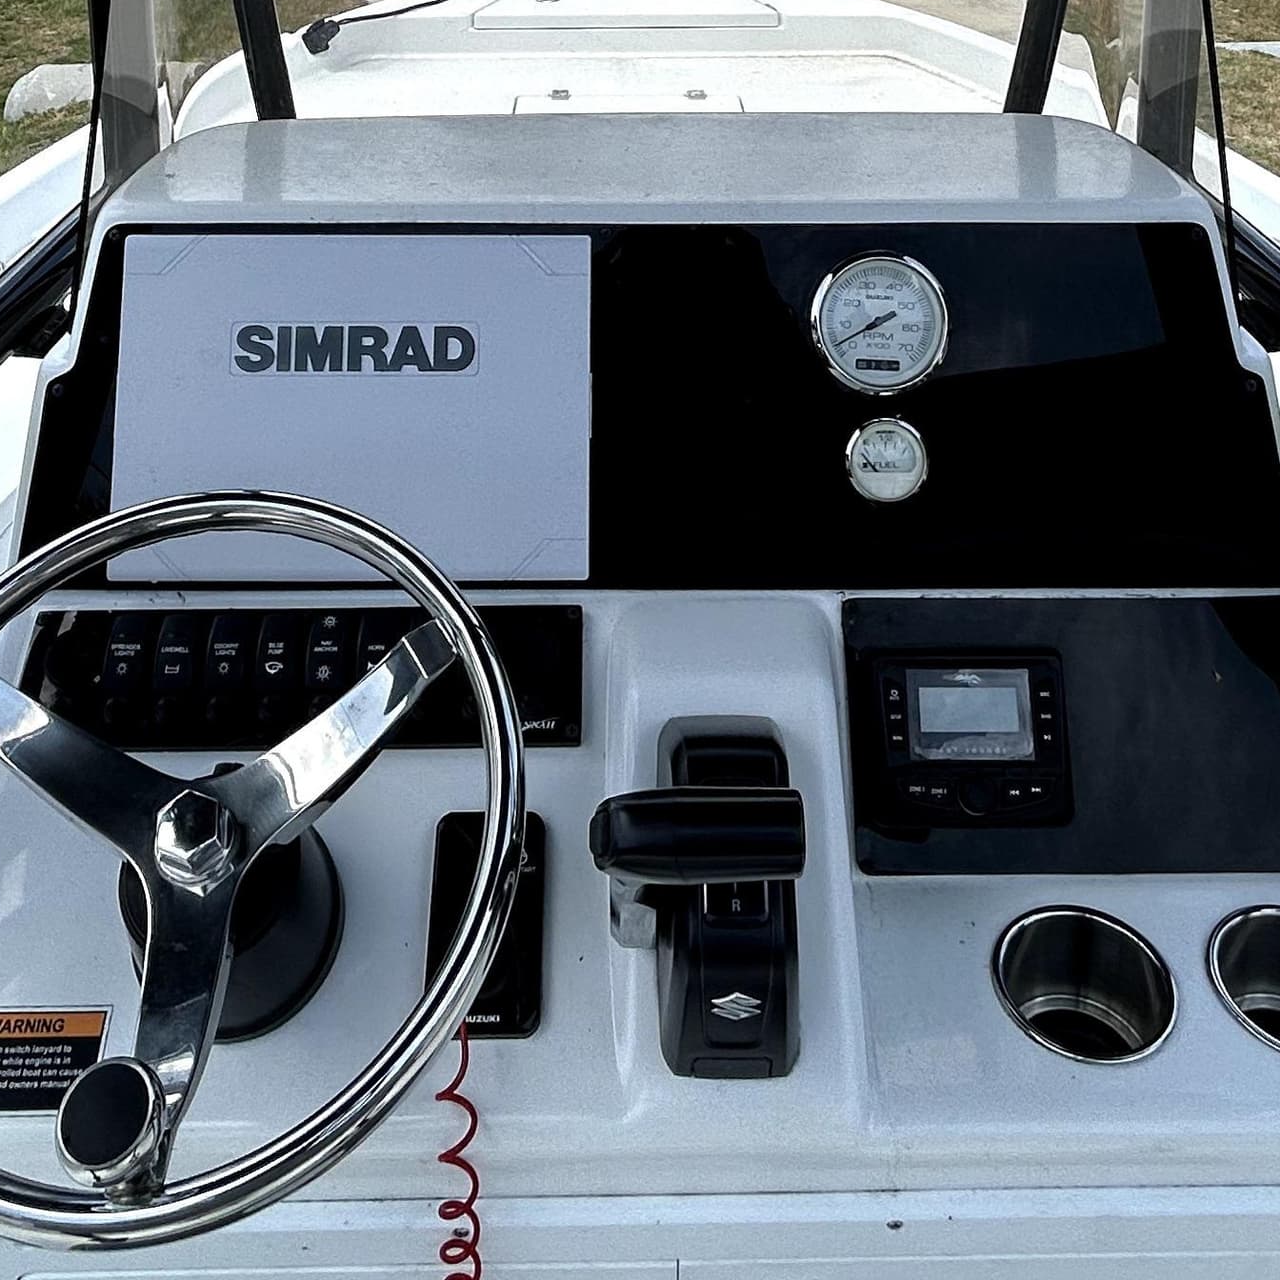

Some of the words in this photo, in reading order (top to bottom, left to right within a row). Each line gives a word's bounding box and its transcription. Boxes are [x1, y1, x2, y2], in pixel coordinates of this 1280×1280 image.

[859, 281, 876, 289] 30
[886, 282, 903, 290] 40
[844, 298, 860, 307] 20
[898, 301, 914, 310] 50
[840, 320, 851, 328] 10
[903, 323, 919, 332] 60
[863, 331, 893, 341] RPM
[234, 324, 476, 372] SIMRAD
[849, 340, 857, 349] 0
[898, 343, 913, 352] 70
[731, 898, 742, 912] R
[4, 1045, 31, 1054] switch
[31, 1045, 63, 1055] lanyard
[63, 1045, 73, 1054] to
[2, 1056, 24, 1066] while
[24, 1057, 53, 1067] engine
[53, 1056, 62, 1065] is
[62, 1056, 72, 1065] in
[22, 1068, 42, 1078] boat
[42, 1069, 58, 1077] can
[8, 1081, 39, 1089] owners
[40, 1079, 71, 1089] manual
